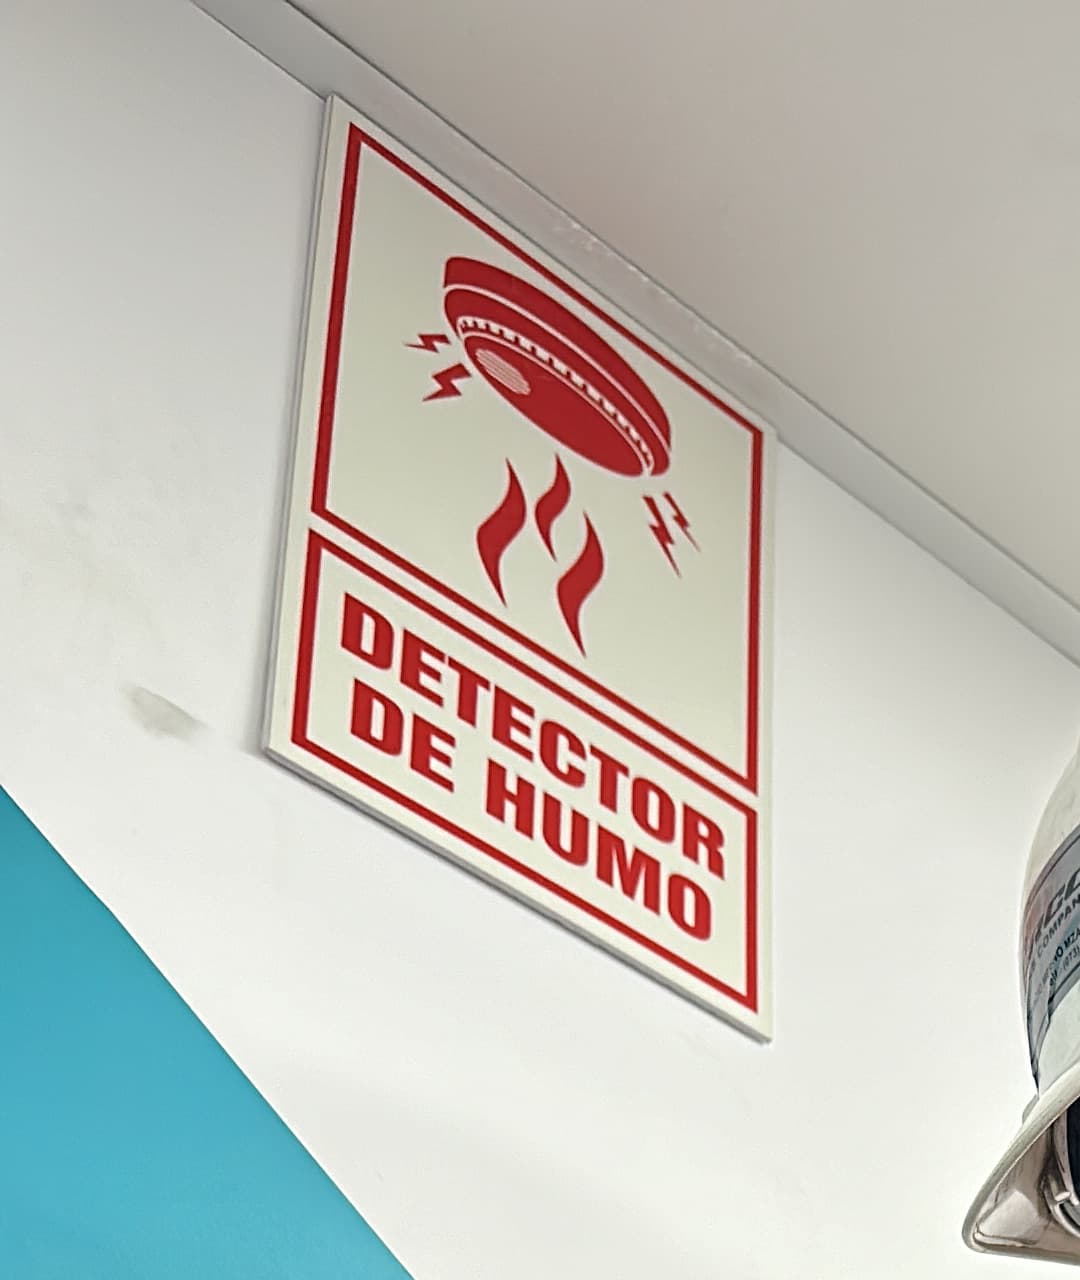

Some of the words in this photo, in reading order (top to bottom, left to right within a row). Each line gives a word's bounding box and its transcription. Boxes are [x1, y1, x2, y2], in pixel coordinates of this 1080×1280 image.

[340, 592, 725, 880] DETECTOR
[350, 678, 456, 794] DE
[486, 758, 712, 942] HUMO
